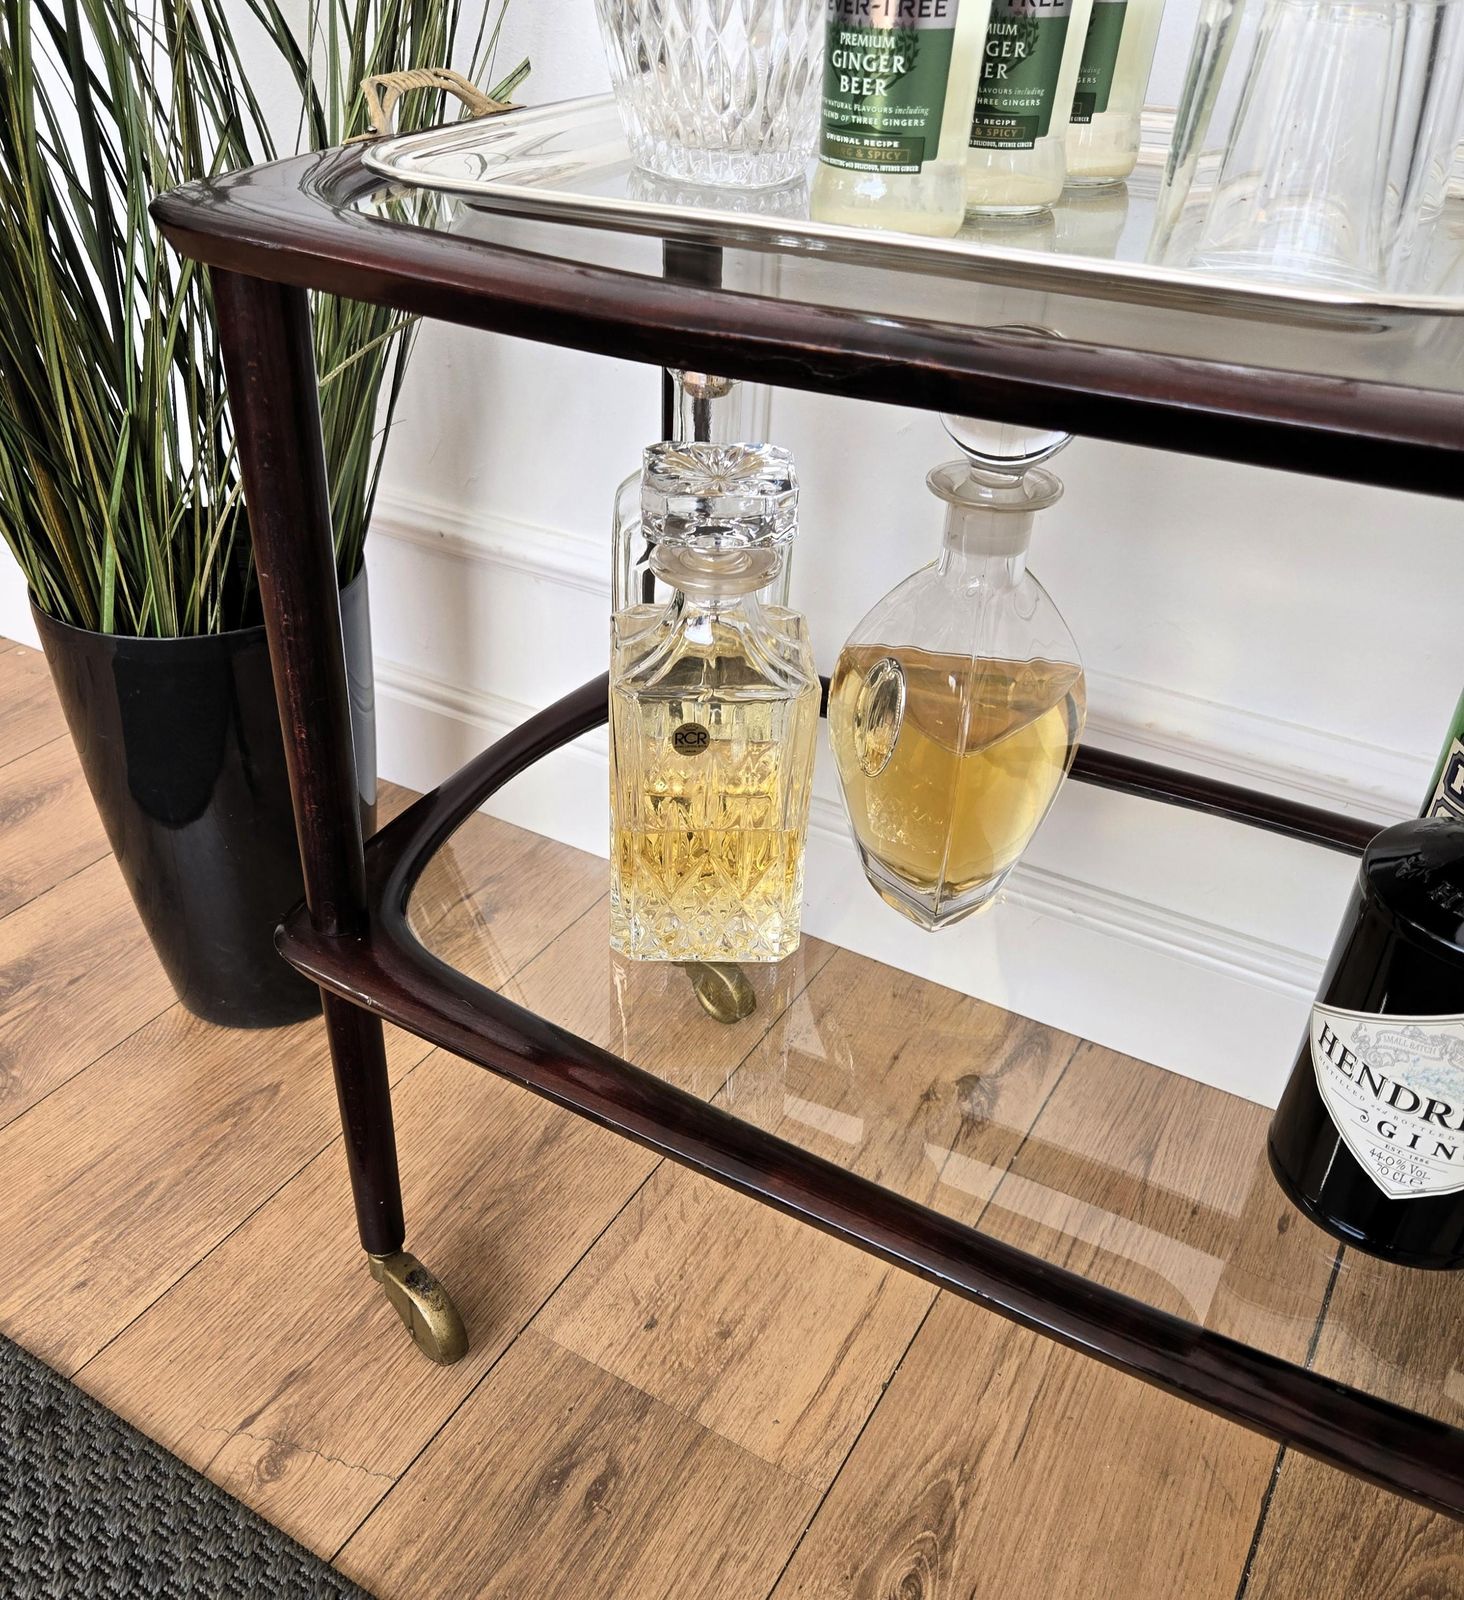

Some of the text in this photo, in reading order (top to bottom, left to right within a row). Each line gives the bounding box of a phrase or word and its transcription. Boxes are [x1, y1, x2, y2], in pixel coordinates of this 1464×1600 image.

[986, 23, 1018, 36] MIUM
[840, 31, 896, 49] PREMIUM
[986, 40, 1027, 58] GER
[832, 49, 906, 74] GINGER
[839, 74, 888, 97] BEER
[979, 87, 1045, 96] LAVOURS including
[977, 97, 999, 106] HREE
[853, 103, 893, 115] FLAVOURS
[894, 105, 930, 117] including
[840, 114, 849, 123] OF
[851, 115, 878, 126] THREE
[882, 118, 926, 127] GINGERS
[983, 118, 1017, 126] RECIPE
[986, 128, 1018, 137] SPICY
[826, 132, 900, 149] ORIGINAL RECIPE
[855, 148, 865, 159] &
[867, 149, 902, 161] SPICY
[674, 731, 707, 745] RCR
[1393, 1115, 1456, 1141] BOTTLED
[1376, 1120, 1459, 1161] GIN
[1384, 1144, 1405, 1157] EST.
[1369, 1148, 1406, 1171] 44.0%
[1377, 1162, 1390, 1176] 70
